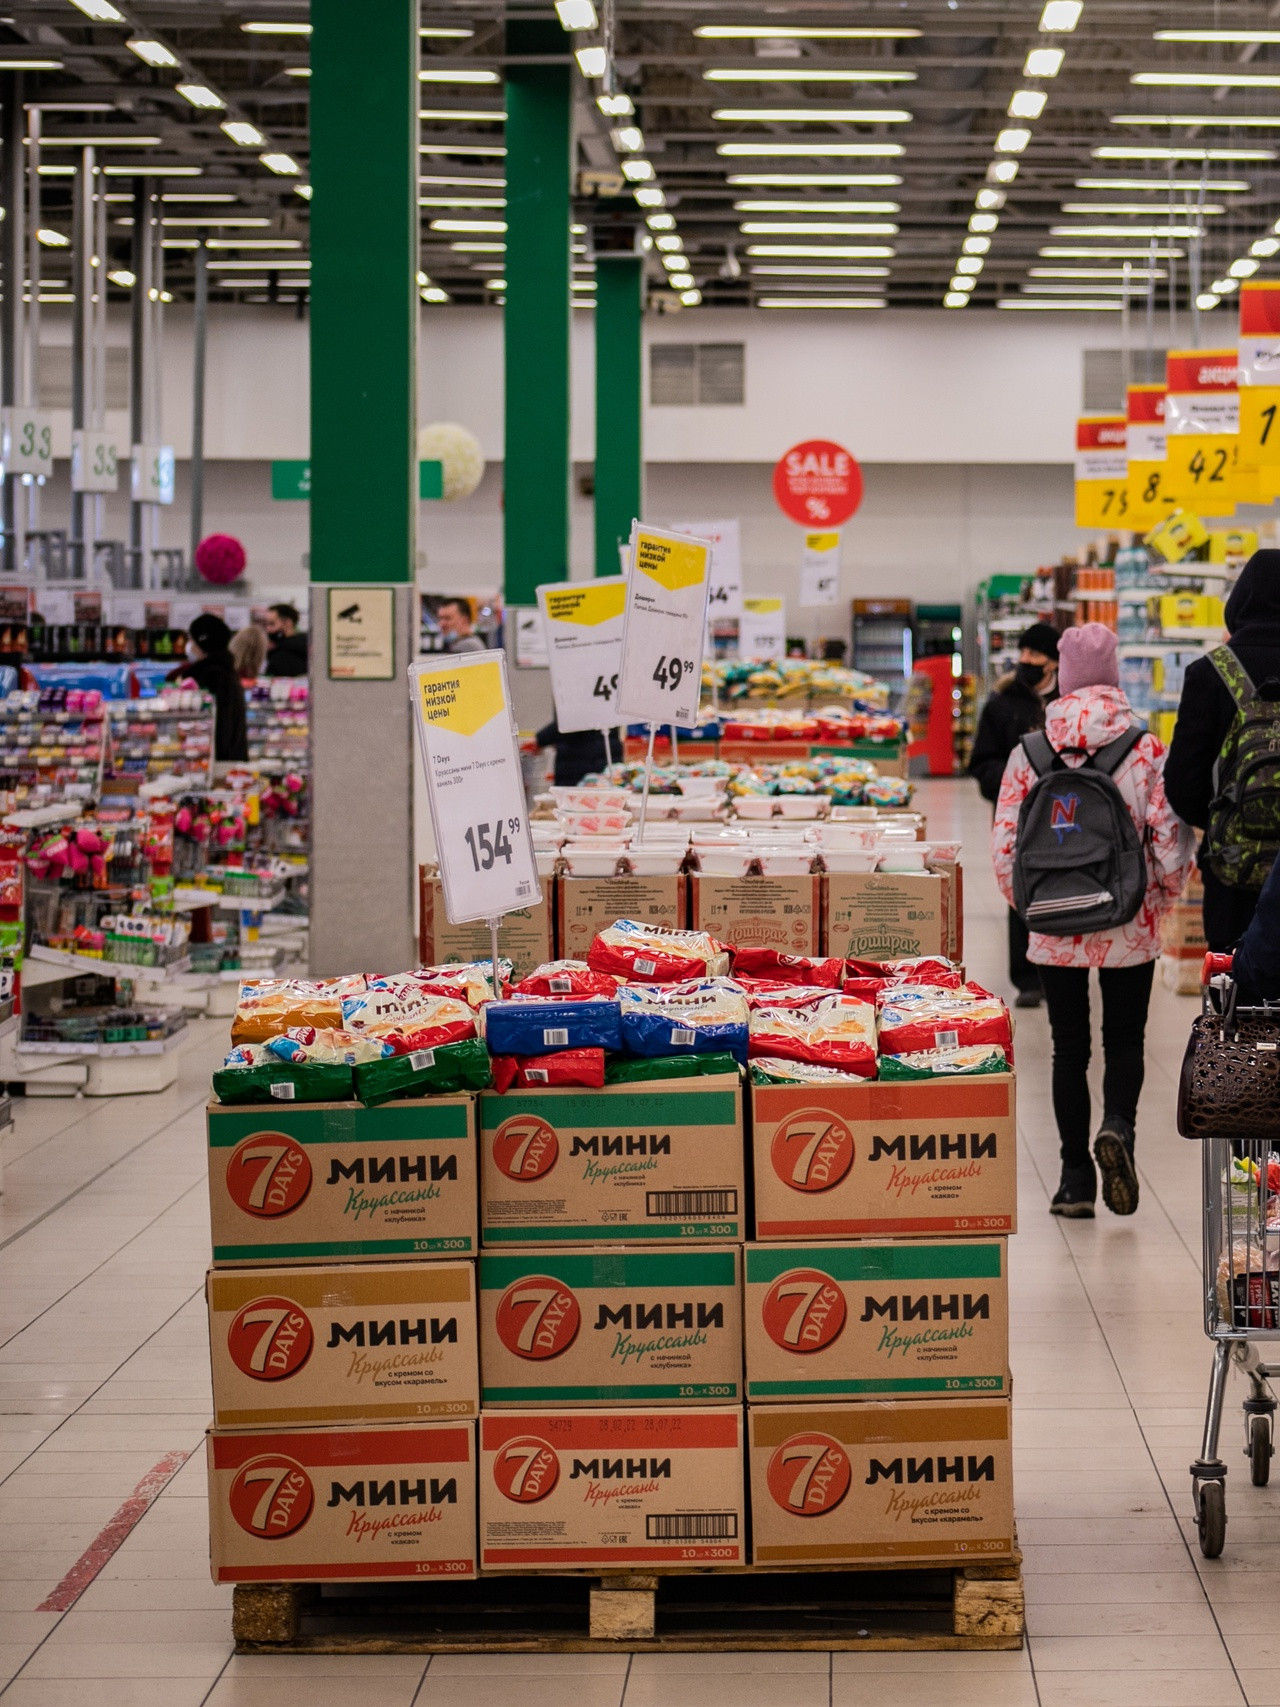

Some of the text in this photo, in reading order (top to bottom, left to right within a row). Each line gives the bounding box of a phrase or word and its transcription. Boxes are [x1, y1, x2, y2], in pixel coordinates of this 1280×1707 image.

[785, 452, 849, 476] SALE
[640, 550, 665, 562] низкой
[641, 541, 671, 554] гарантия
[639, 561, 658, 571] цены
[423, 679, 460, 695] гарантия
[425, 690, 457, 708] низкой
[427, 709, 450, 721] цены
[437, 755, 450, 765] Days
[1051, 799, 1077, 824] N
[845, 935, 921, 959] Доширак
[504, 1125, 553, 1174] 7 DAYS
[569, 1134, 671, 1157] МИНИ
[786, 1121, 847, 1186] 7 DAYS
[868, 1132, 997, 1161] МИНИ
[242, 1145, 303, 1209] 7 DAYS
[326, 1155, 458, 1185] МИНИ
[582, 1157, 658, 1185] Круассаны
[886, 1161, 983, 1198] Круассаны
[343, 1183, 441, 1220] Круассаны
[934, 1184, 962, 1192] кремом
[391, 1207, 425, 1216] начинкой
[510, 1288, 572, 1354] 7 DAYS
[593, 1302, 724, 1330] МИНИ
[778, 1281, 838, 1346] 7 DAYS
[860, 1293, 990, 1323] МИНИ
[243, 1308, 305, 1373] 7 DAYS
[326, 1317, 458, 1348] МИНИ
[877, 1322, 975, 1357] Круассаны
[610, 1330, 707, 1366] Круассаны
[923, 1344, 958, 1353] начинкой
[347, 1346, 444, 1384] Круассаны
[505, 1446, 554, 1497] 7 DAYS
[569, 1457, 671, 1479] МИНИ
[782, 1443, 844, 1510] 7 DAYS
[864, 1454, 995, 1485] МИНИ
[243, 1467, 306, 1531] 7 DAYS
[326, 1477, 457, 1508] МИНИ
[583, 1479, 660, 1507] Круассаны
[885, 1485, 982, 1522] Круассаны
[345, 1506, 443, 1544] Круассаны
[911, 1517, 937, 1525] вкусом
[931, 1507, 958, 1515] кремом
